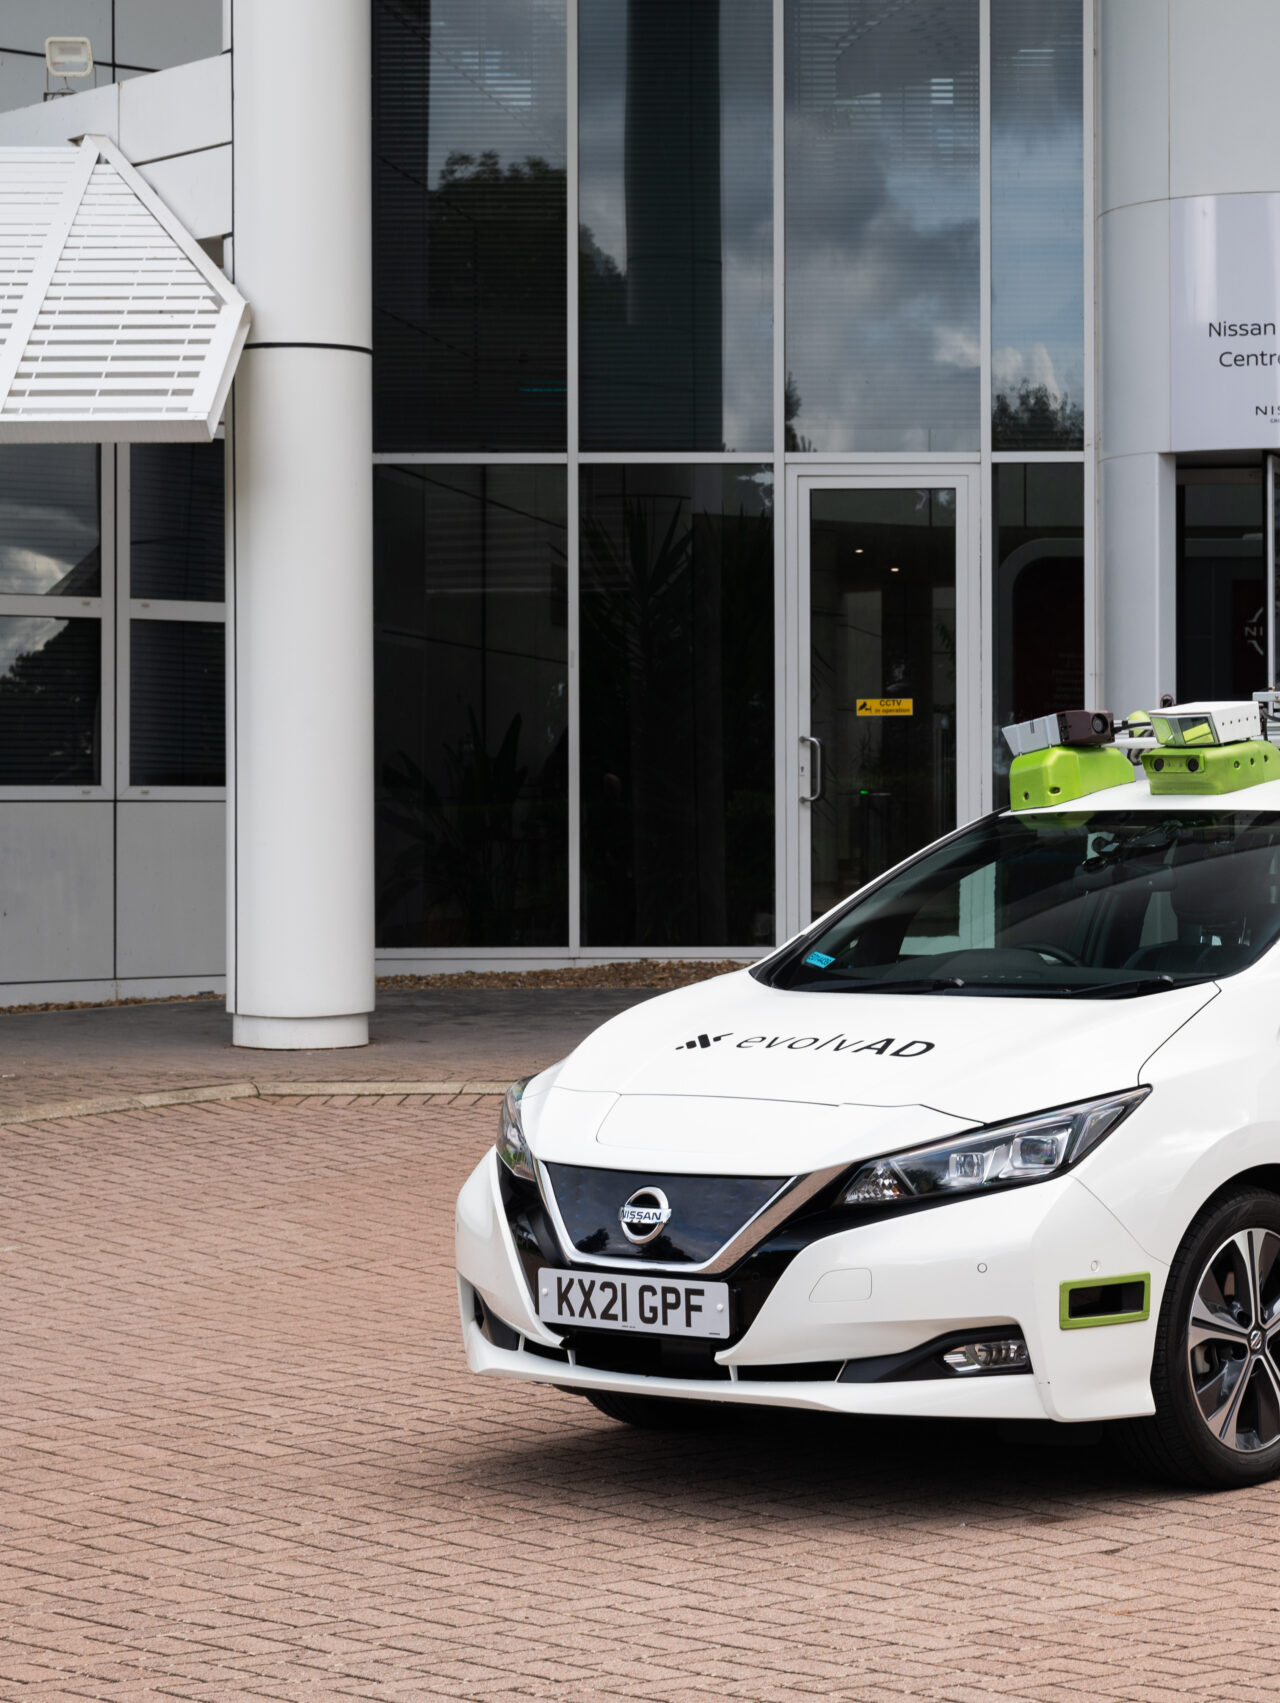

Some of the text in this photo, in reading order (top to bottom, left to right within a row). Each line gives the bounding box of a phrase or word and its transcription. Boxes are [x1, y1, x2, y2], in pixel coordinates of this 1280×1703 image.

[1208, 320, 1276, 338] Nissan
[736, 1033, 935, 1057] evolvAD
[620, 1209, 662, 1221] NISSAN
[557, 1276, 705, 1328] KX21 GPF
